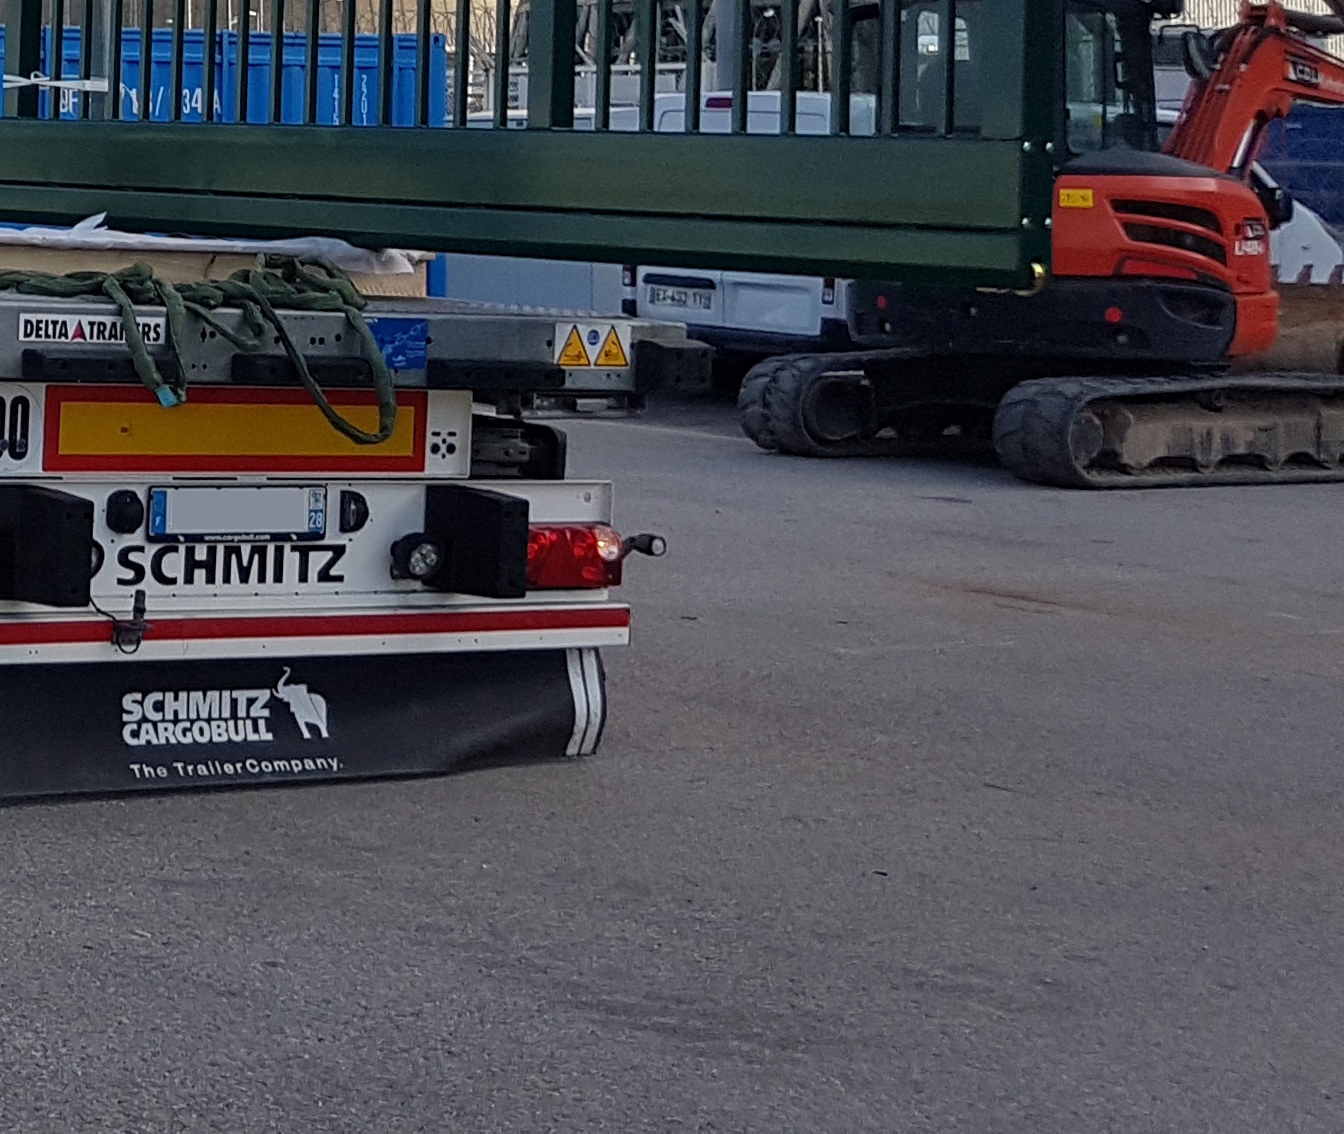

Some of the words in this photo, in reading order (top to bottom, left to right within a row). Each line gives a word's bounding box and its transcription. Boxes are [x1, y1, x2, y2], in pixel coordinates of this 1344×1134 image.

[23, 319, 69, 340] DELTA
[88, 320, 161, 342] TRAIRS
[309, 512, 323, 528] 28
[116, 544, 346, 586] SCHMITZ
[122, 689, 271, 722] SCHMITZ
[122, 719, 273, 745] CARGOBULL
[129, 763, 168, 778] The
